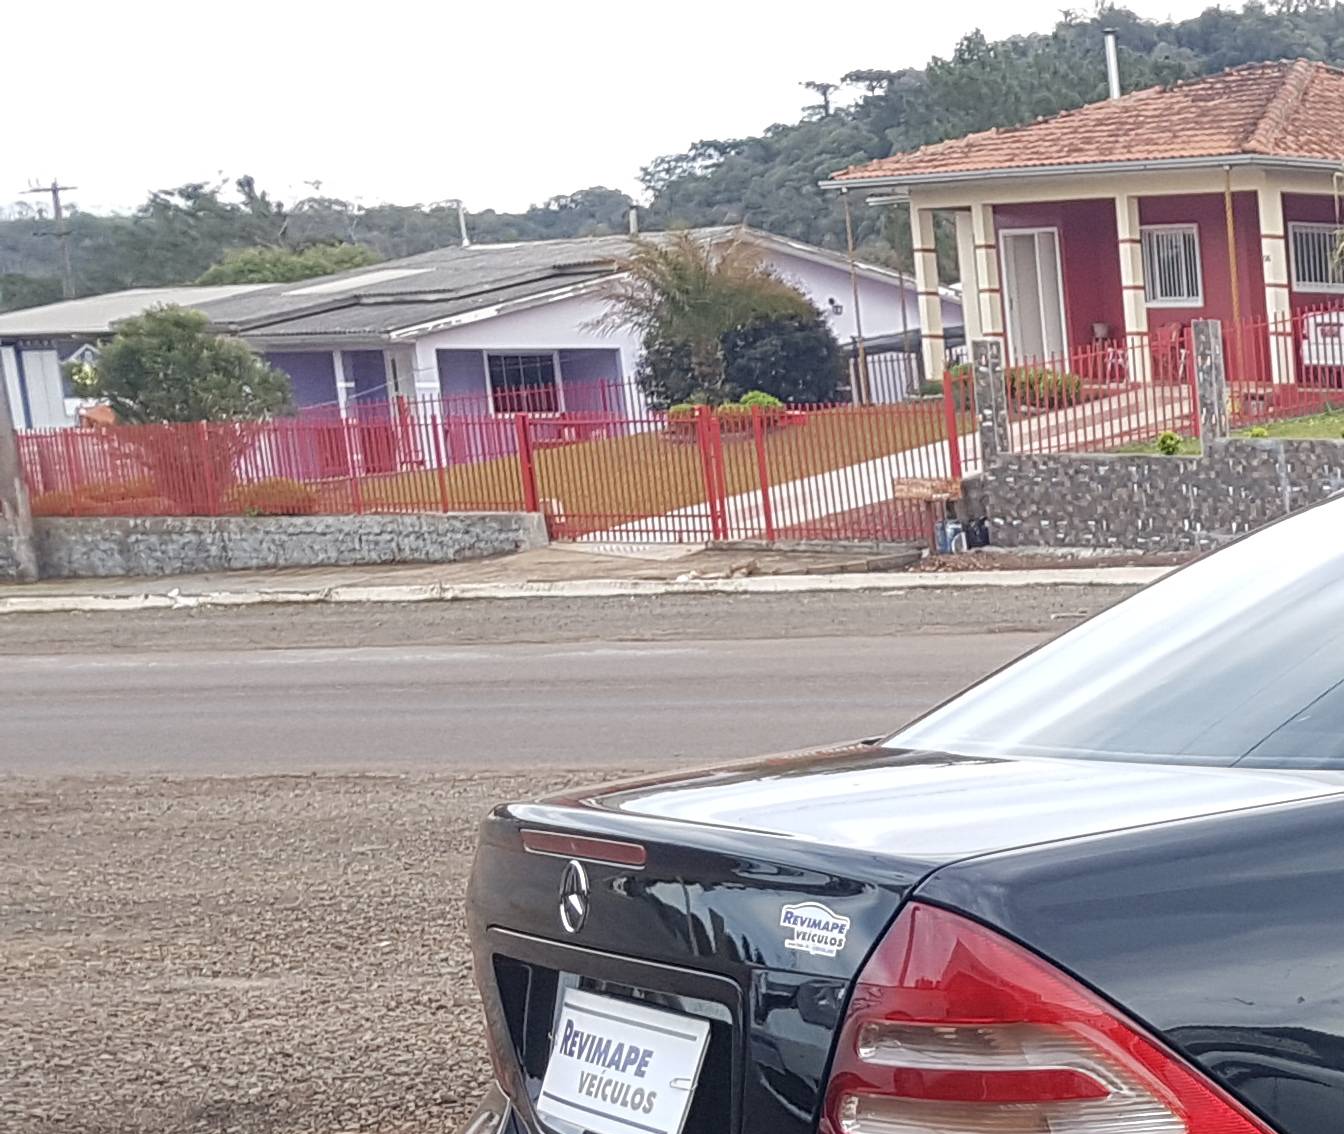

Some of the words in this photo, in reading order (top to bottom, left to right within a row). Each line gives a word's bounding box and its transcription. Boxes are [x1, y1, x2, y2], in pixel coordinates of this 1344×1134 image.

[782, 910, 847, 934] REVIMAPE
[559, 1018, 654, 1078] REVIMAPE
[578, 1068, 657, 1114] VEÍCULOS
